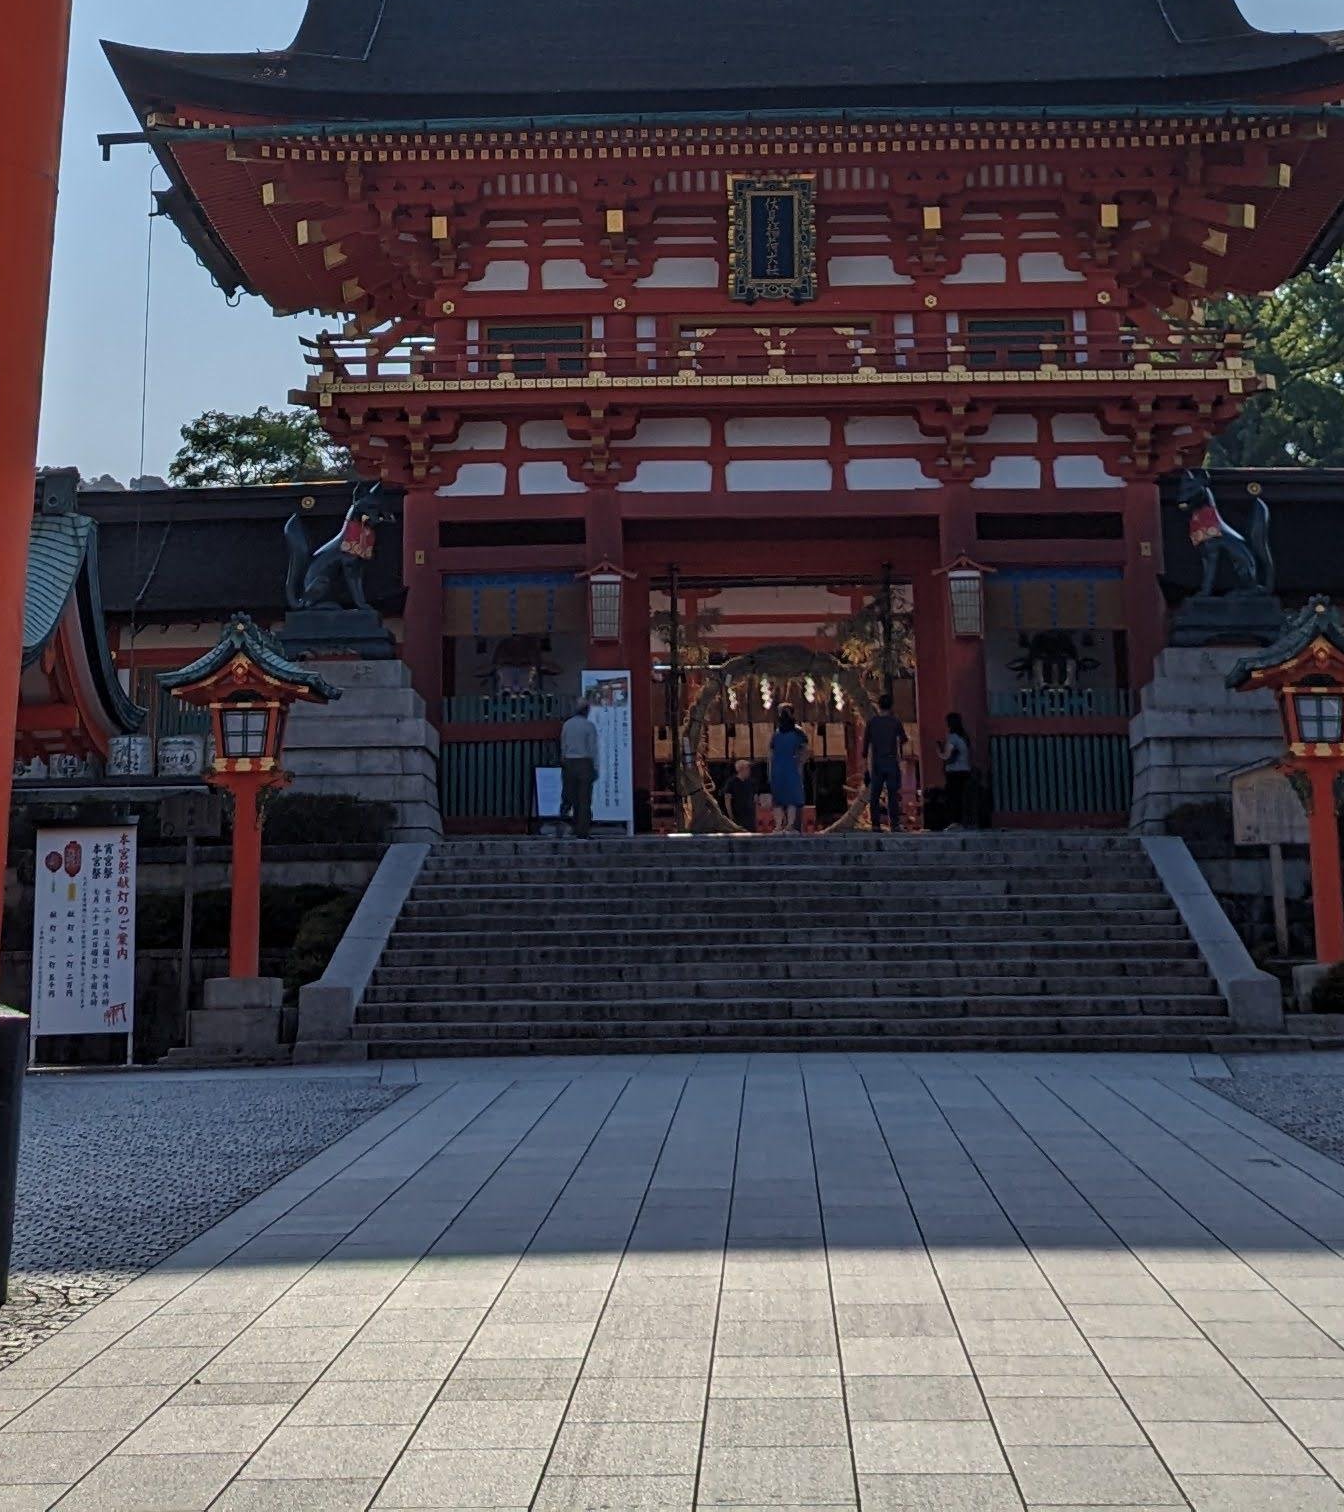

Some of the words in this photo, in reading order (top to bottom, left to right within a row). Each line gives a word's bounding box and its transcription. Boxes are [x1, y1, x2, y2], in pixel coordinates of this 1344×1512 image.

[91, 842, 102, 879] 本宮祭
[103, 842, 114, 879] 宵宮祭
[116, 831, 131, 961] 本宮祭献灯のご案内
